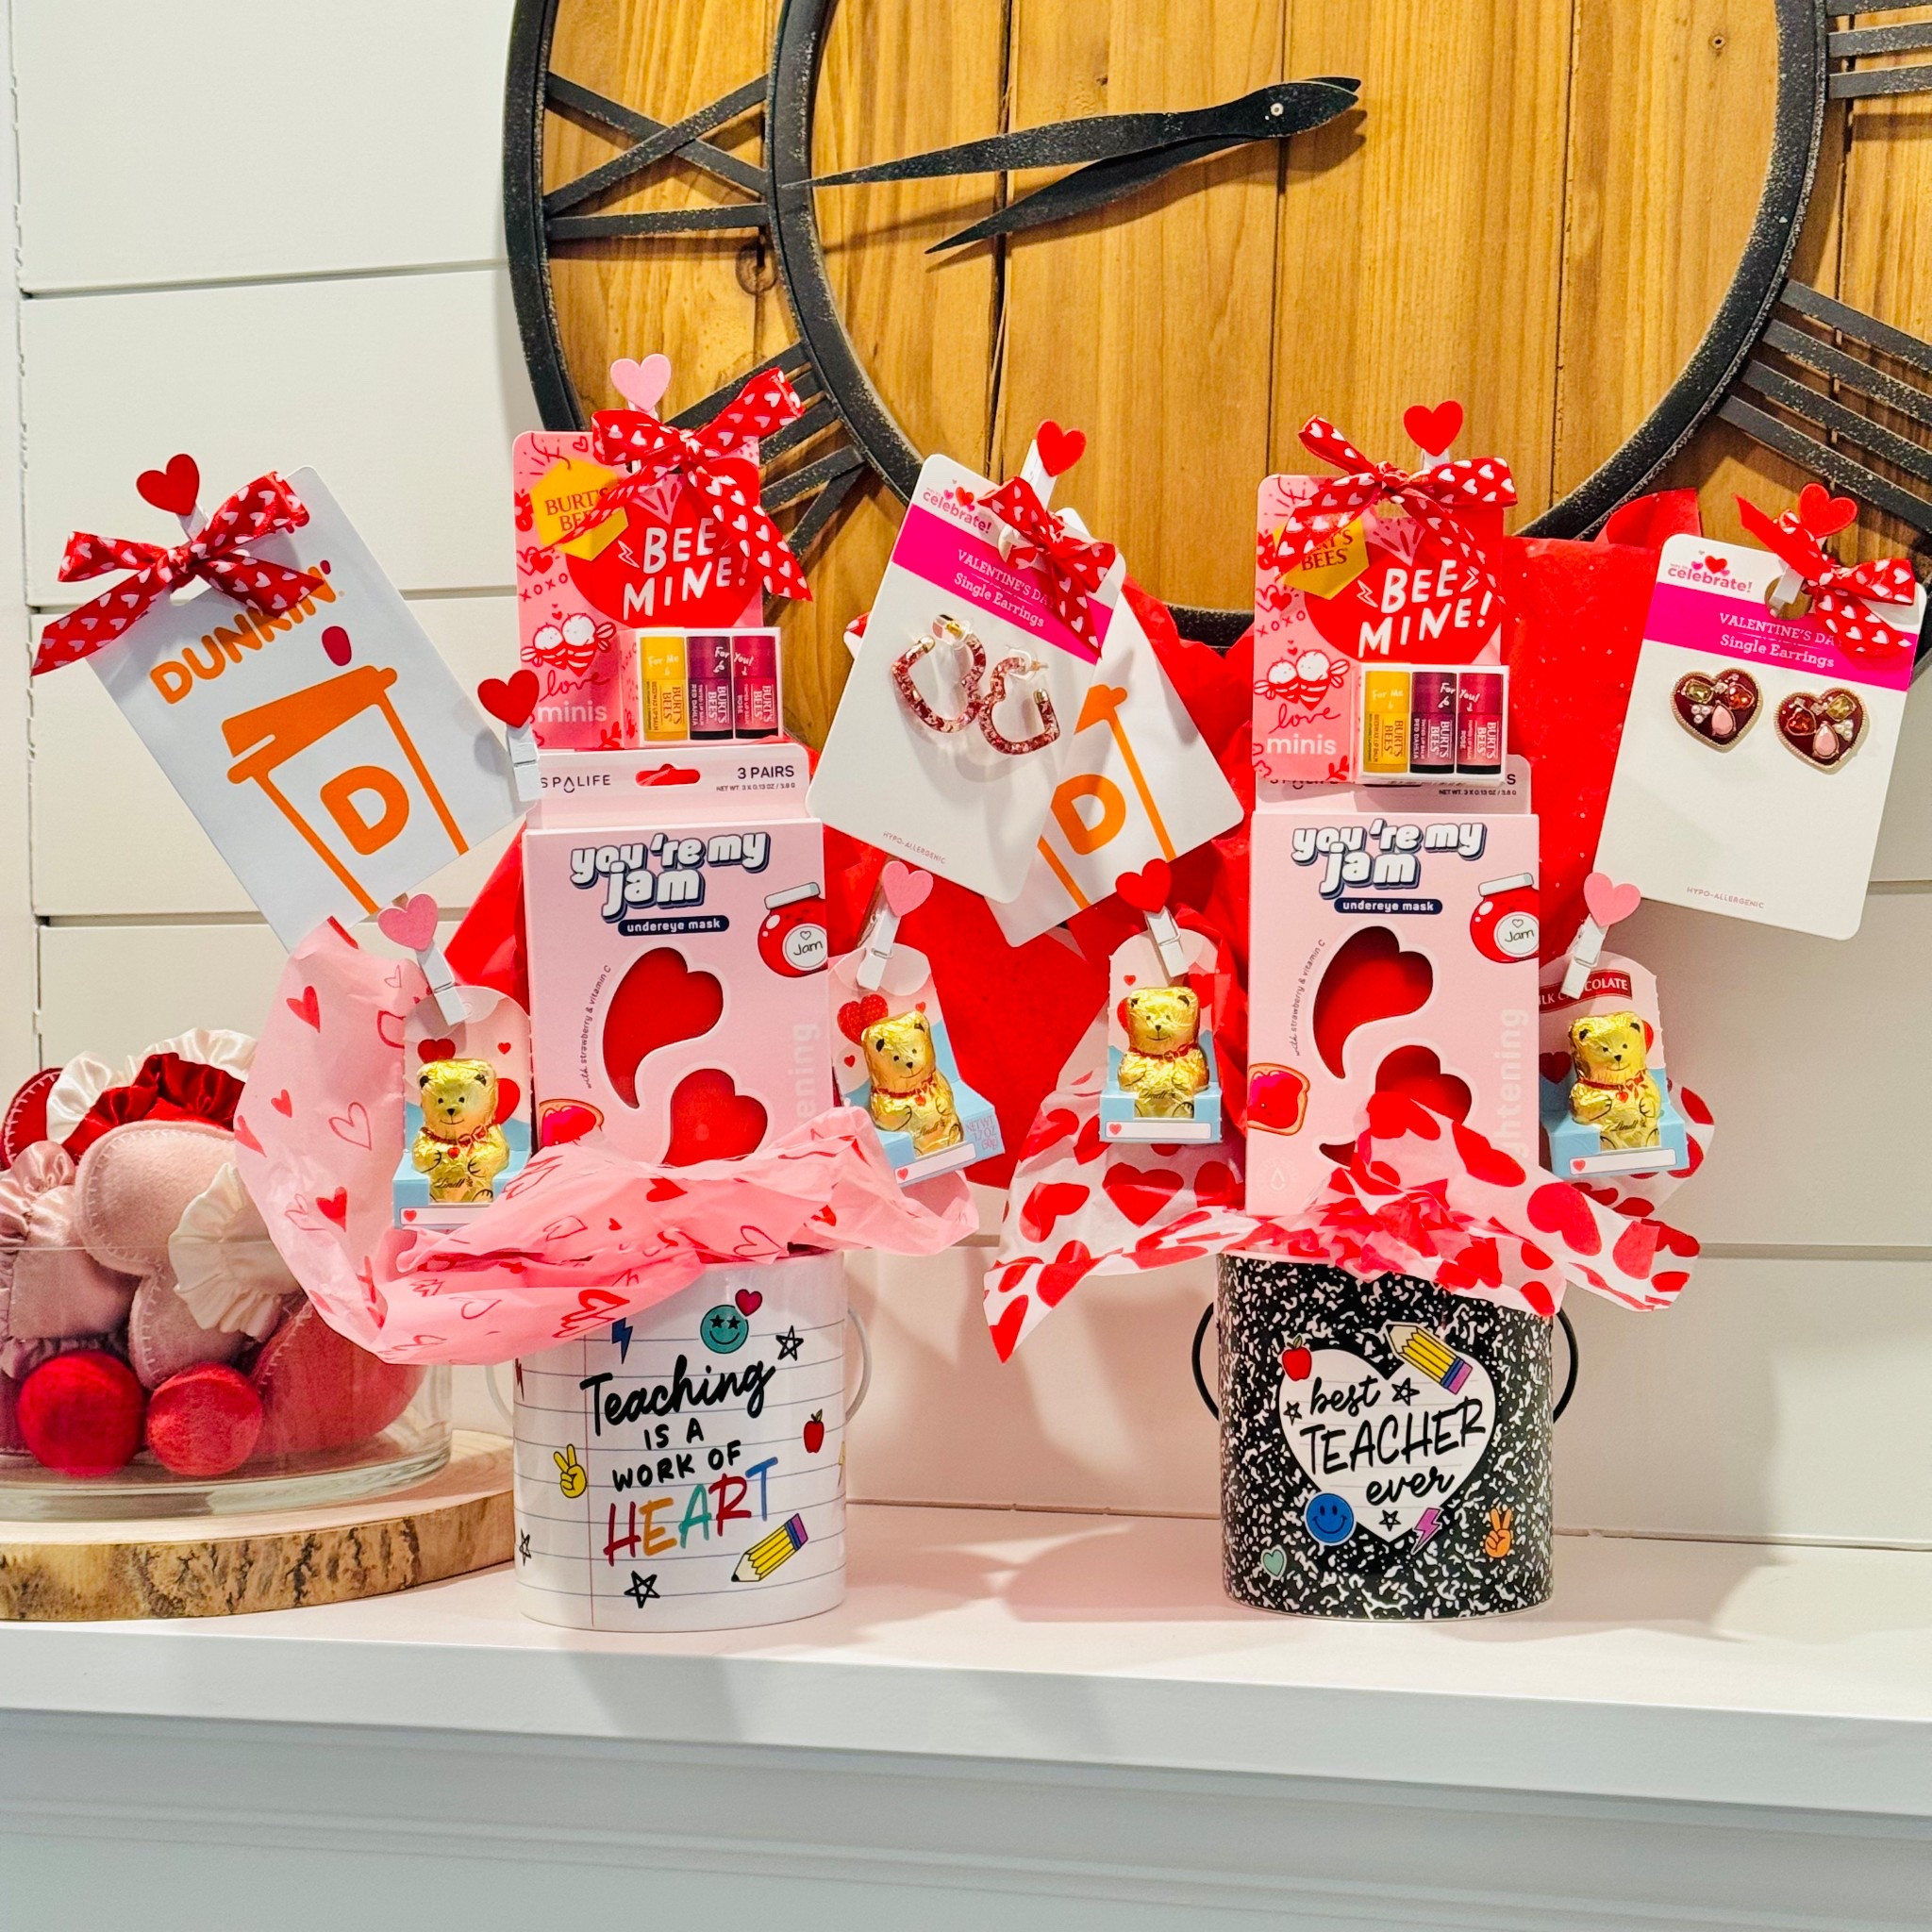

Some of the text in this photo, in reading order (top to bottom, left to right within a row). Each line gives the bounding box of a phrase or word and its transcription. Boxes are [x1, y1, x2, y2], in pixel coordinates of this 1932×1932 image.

[923, 491, 991, 534] celebrate!
[643, 517, 716, 575] BEE
[1302, 548, 1348, 571] BEES
[623, 557, 749, 621] MINE!
[958, 549, 1031, 596] VALENTINE'S
[1381, 558, 1458, 613] BEE
[1668, 567, 1753, 593] celebrate!
[954, 572, 1044, 628] Single Earrings
[1358, 590, 1492, 658] MINE!
[1720, 612, 1812, 641] VALENTINE'S
[714, 646, 754, 667] For You!
[1720, 634, 1835, 669] Single Earrings
[539, 670, 610, 703] love
[672, 686, 682, 724] BURT'S
[708, 691, 718, 719] BEES
[717, 686, 727, 724] BURT'S
[753, 691, 763, 718] BEES
[762, 685, 773, 723] BURT'S
[1440, 683, 1481, 703] For You!
[537, 700, 608, 723] minis
[1268, 703, 1341, 734] love
[1267, 733, 1337, 755] minis
[1384, 725, 1393, 752] BEES
[1394, 721, 1404, 758] BURT'S
[1430, 726, 1441, 753] BEES
[1440, 721, 1450, 758] BURT'S
[1477, 726, 1487, 754] BEES
[1487, 722, 1497, 759] BURT'S
[737, 765, 795, 779] 3 PAIRS
[320, 766, 409, 856] D
[1050, 774, 1126, 856] D
[707, 831, 771, 874] my
[1424, 823, 1487, 861] my
[1319, 841, 1421, 900] jam
[601, 860, 706, 924] jam
[1342, 902, 1434, 913] undereye mask
[626, 918, 721, 934] undereye mask
[1504, 928, 1535, 943] Jam
[792, 941, 824, 957] Jam
[1291, 986, 1306, 1031] strawberry
[1303, 947, 1321, 976] vitamin
[1318, 939, 1325, 947] C
[1540, 991, 1556, 1005] ILK
[580, 1015, 593, 1064] strawberry
[590, 974, 608, 1005] vitamin
[604, 964, 611, 974] C
[580, 1354, 776, 1437] Teaching
[1309, 1374, 1381, 1418] best
[644, 1418, 705, 1450] IS A
[1300, 1396, 1486, 1475] TEACHER
[612, 1440, 741, 1491] WORK OF
[1366, 1466, 1456, 1506] ever
[603, 1457, 778, 1567] HEART
